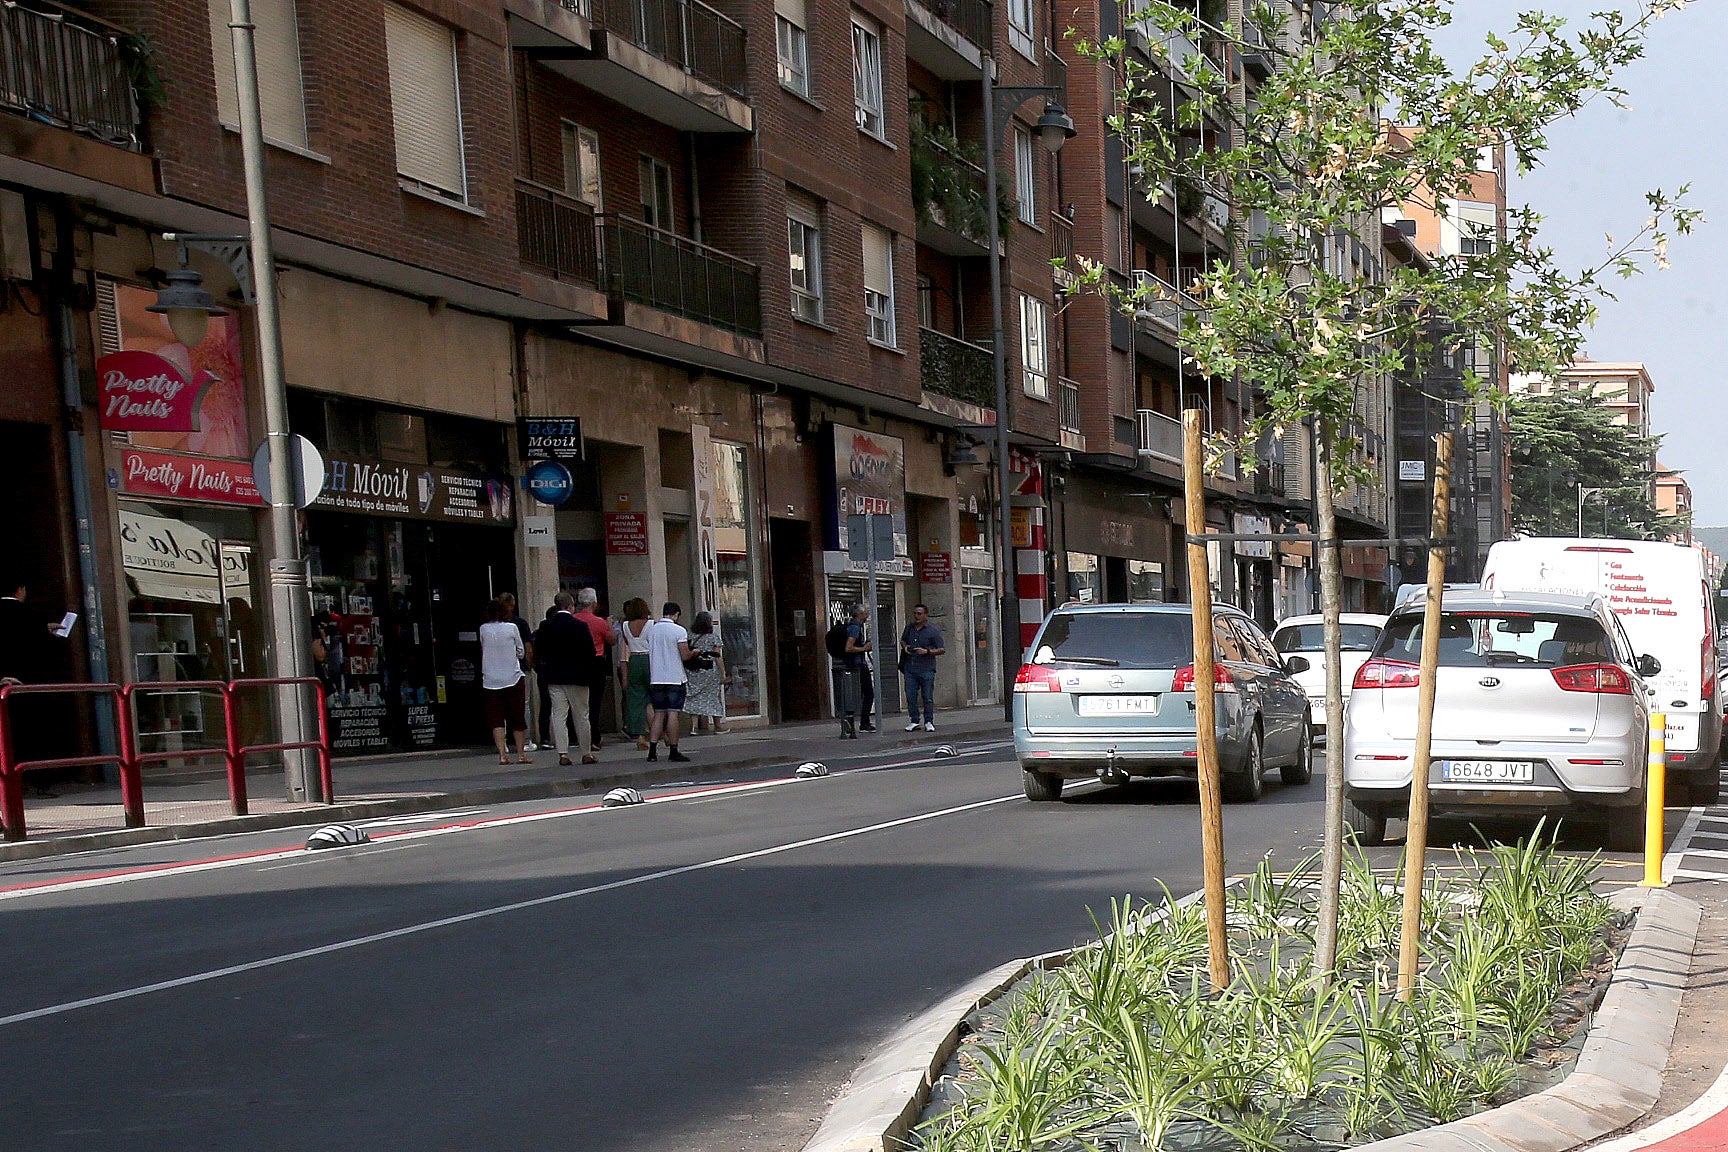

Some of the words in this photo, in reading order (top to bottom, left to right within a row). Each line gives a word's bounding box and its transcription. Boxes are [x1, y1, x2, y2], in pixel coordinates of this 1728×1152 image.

[104, 370, 185, 399] Pretty
[106, 395, 173, 418] Nails
[127, 454, 185, 494] Pretty
[189, 464, 234, 494] Nails
[352, 463, 409, 501] Móvil
[441, 475, 462, 485] SERVICIO
[463, 477, 482, 488] TÉCNICO
[530, 479, 567, 489] DIGI
[314, 494, 334, 505] ación
[336, 495, 345, 506] de
[346, 497, 361, 508] todo
[361, 499, 374, 511] tipo
[376, 500, 384, 511] de
[385, 502, 409, 513] móviles
[449, 497, 477, 507] ACCESORIOS
[464, 509, 468, 517] Y
[468, 509, 484, 518] TABLET
[528, 527, 548, 535] Lowi
[1481, 677, 1498, 686] KIA
[1126, 699, 1150, 710] FMT
[330, 709, 360, 718] SERVICIO
[361, 707, 387, 717] TÉCNICO
[408, 706, 428, 715] SUPER
[340, 718, 379, 727] REPARACIÓN
[340, 728, 380, 737] ACCESORIOS
[333, 738, 361, 748] MÓVILES
[367, 737, 388, 746] TABLET
[1453, 763, 1493, 777] 6648
[1499, 764, 1528, 779] JVT
